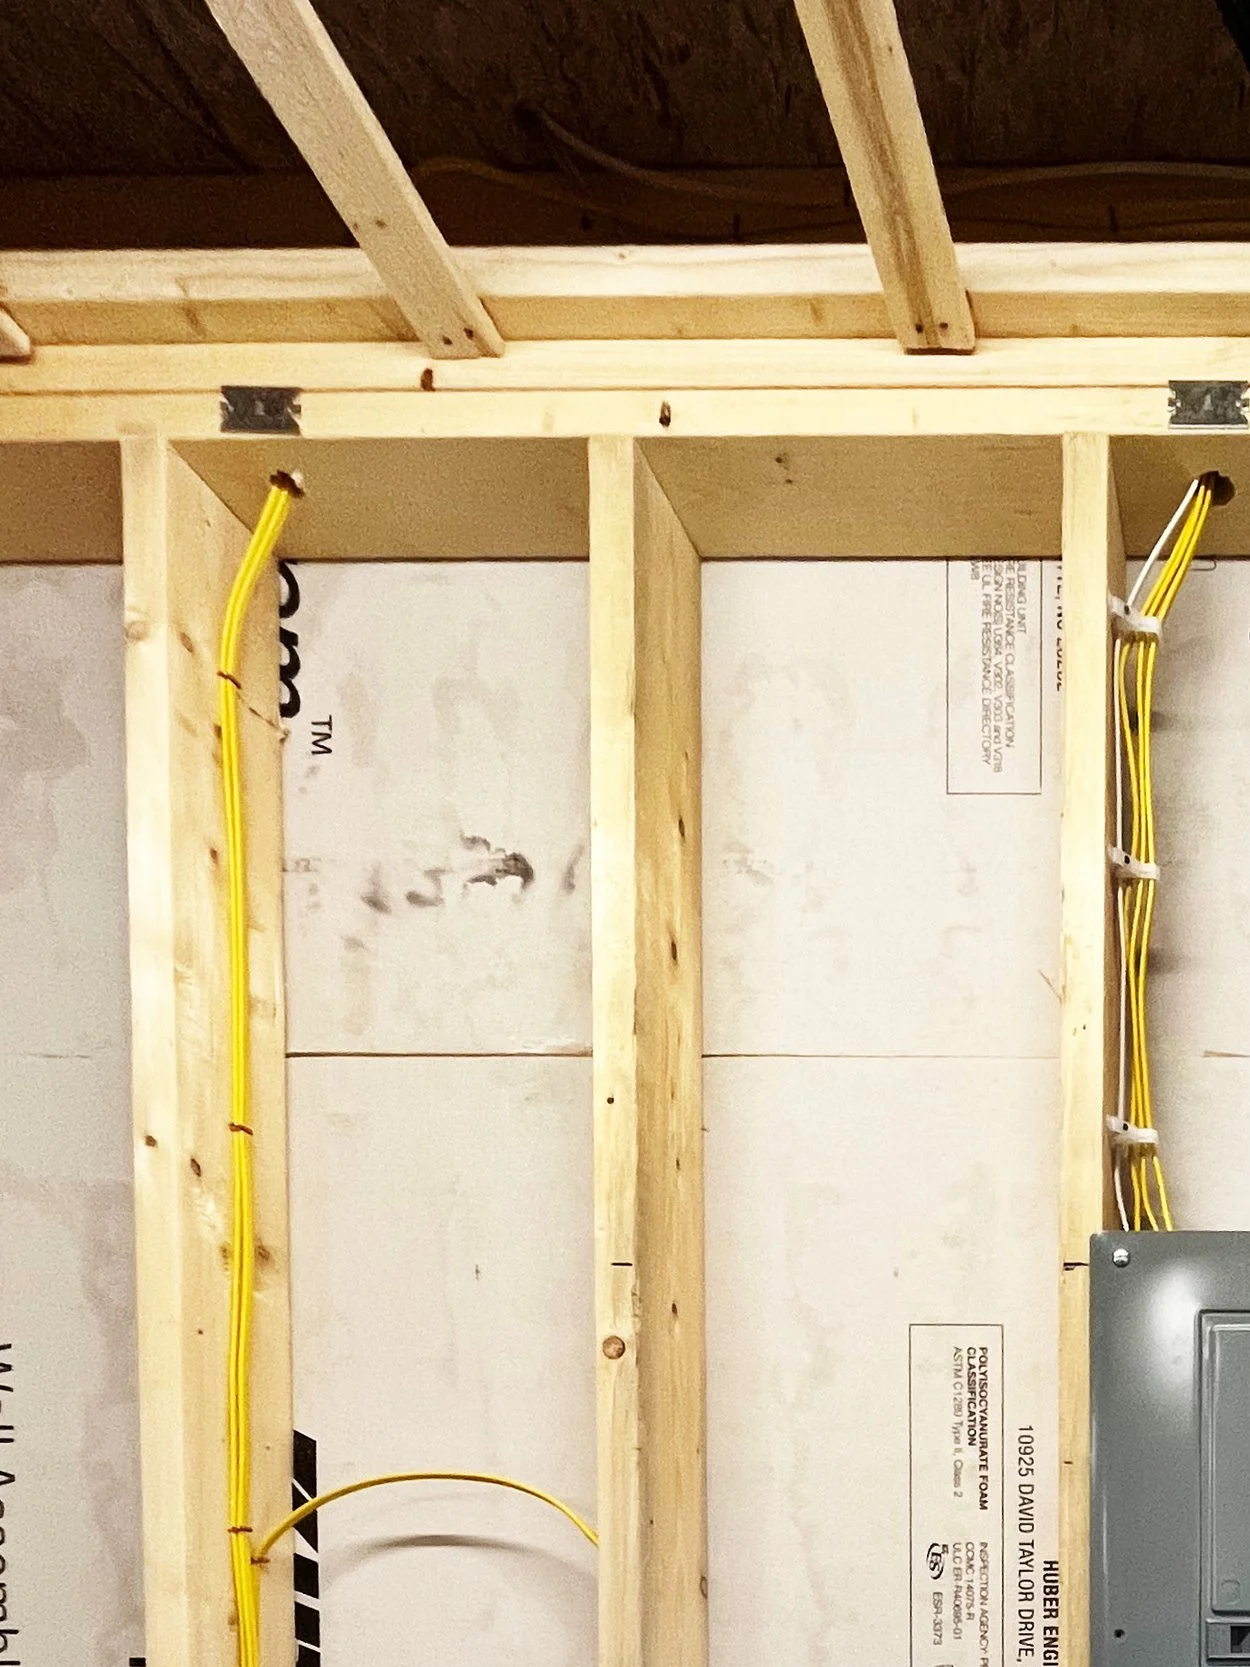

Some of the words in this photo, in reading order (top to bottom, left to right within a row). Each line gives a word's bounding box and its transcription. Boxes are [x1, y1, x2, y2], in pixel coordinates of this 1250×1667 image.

[311, 715, 333, 756] TM
[952, 1346, 963, 1378] ASTM
[967, 1346, 976, 1446] CLASSIFICATION
[978, 1346, 988, 1472] POLYISOCYANURATE
[1018, 1425, 1034, 1477] 10925
[978, 1475, 988, 1510] FOAM
[1018, 1484, 1034, 1534] DAVID
[978, 1542, 989, 1606] INSPECTION
[1018, 1539, 1034, 1602] TAYLOR
[1042, 1560, 1059, 1619] HUBER
[1016, 1608, 1034, 1662] DRIVE,
